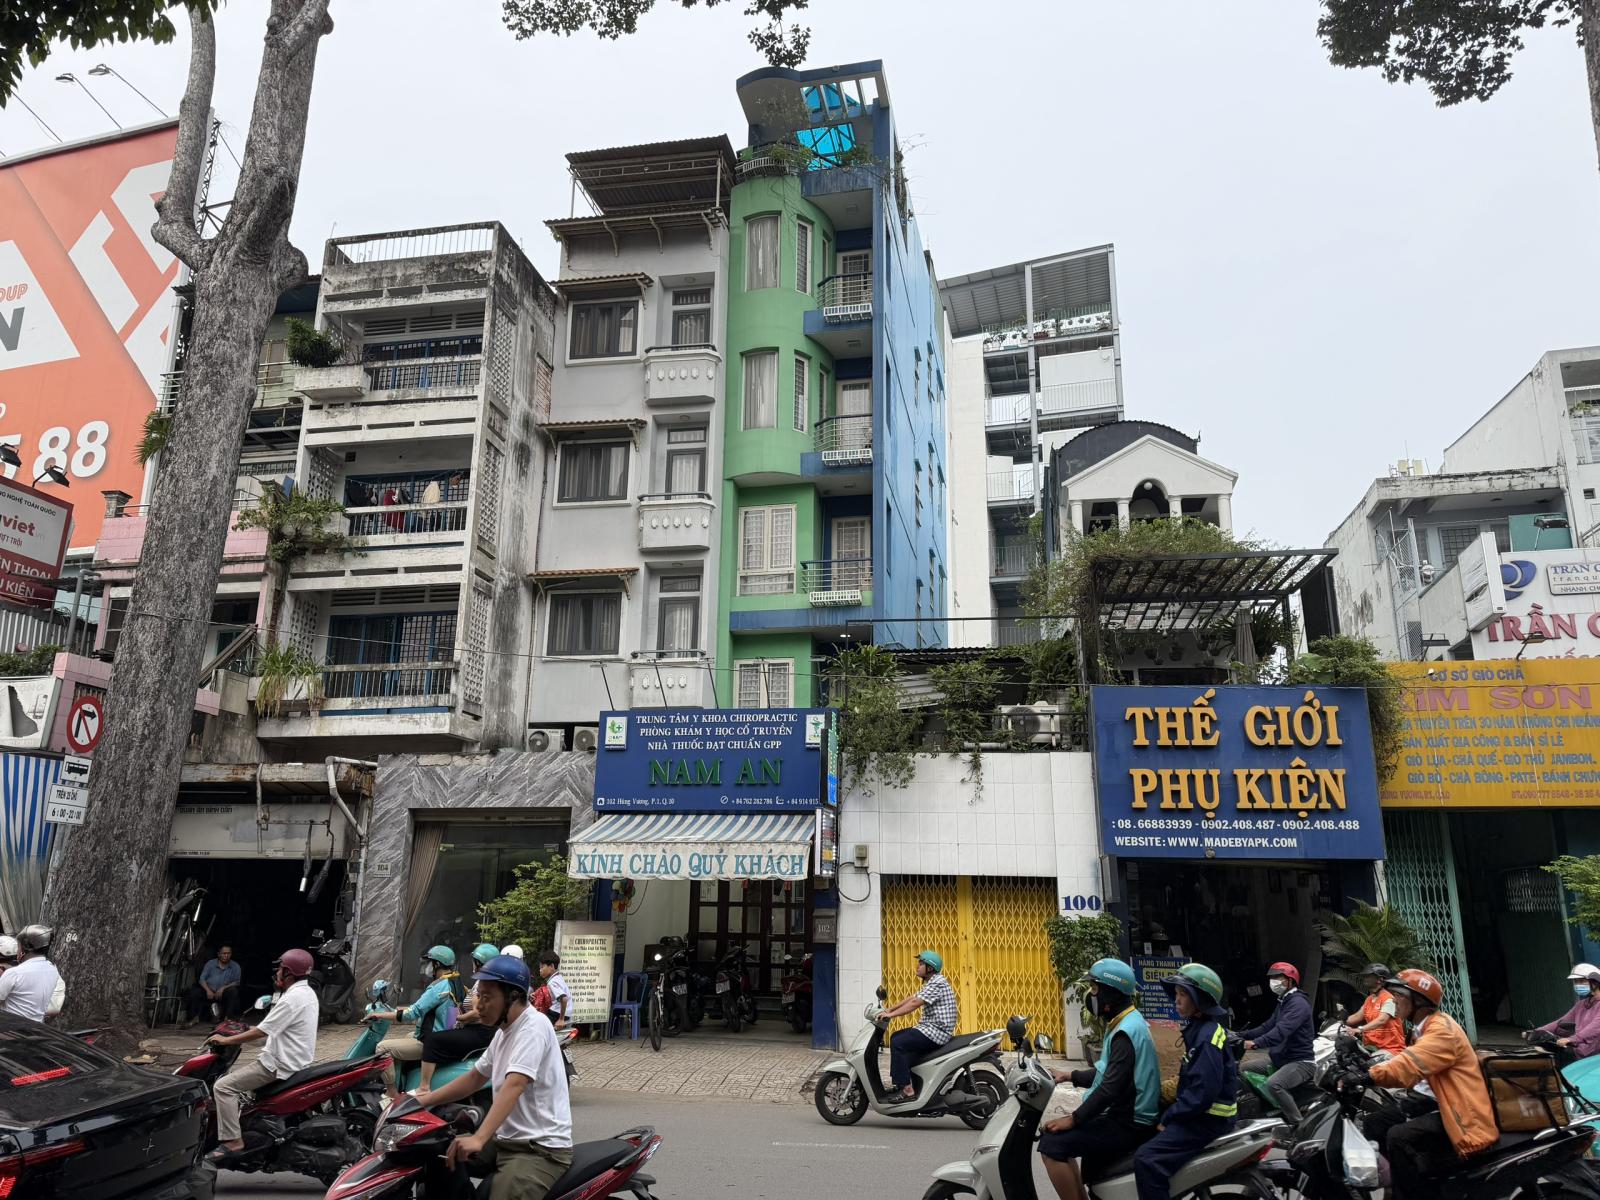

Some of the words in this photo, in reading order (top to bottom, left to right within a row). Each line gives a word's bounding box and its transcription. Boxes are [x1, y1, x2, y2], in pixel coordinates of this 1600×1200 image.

[33, 420, 109, 483] 88
[1472, 667, 1494, 681] GIÒ
[635, 715, 666, 724] TRUNG
[669, 713, 689, 723] TÂM
[692, 714, 699, 723] Y
[701, 714, 727, 723] KHOA
[730, 713, 798, 723] CHIROPRACTIC
[1125, 688, 1220, 746] THẾ
[1243, 690, 1343, 746] GIỚI
[639, 725, 672, 737] PHÒNG
[674, 725, 702, 736] KHÁM
[706, 727, 712, 735] Y
[715, 727, 735, 737] HỌC
[753, 723, 793, 736] TRUYỀN
[647, 739, 668, 750] NHÀ
[671, 737, 704, 750] THUỐC
[706, 741, 725, 751] ĐẠT
[727, 737, 762, 750] CHUẨN
[763, 740, 782, 749] GPP
[648, 757, 723, 786] NAM
[735, 757, 783, 786] AN
[1128, 768, 1221, 818] PHỤ
[1233, 756, 1347, 818] KIỆN
[1201, 819, 1275, 830] 0902.408.487
[1282, 820, 1360, 831] 0902.408.488
[576, 849, 624, 875] KÍNH
[629, 850, 682, 875] CHÀO
[688, 849, 727, 878] QUÝ
[734, 849, 805, 876] KHÁCH
[1061, 894, 1101, 911] 100
[65, 932, 78, 943] 84
